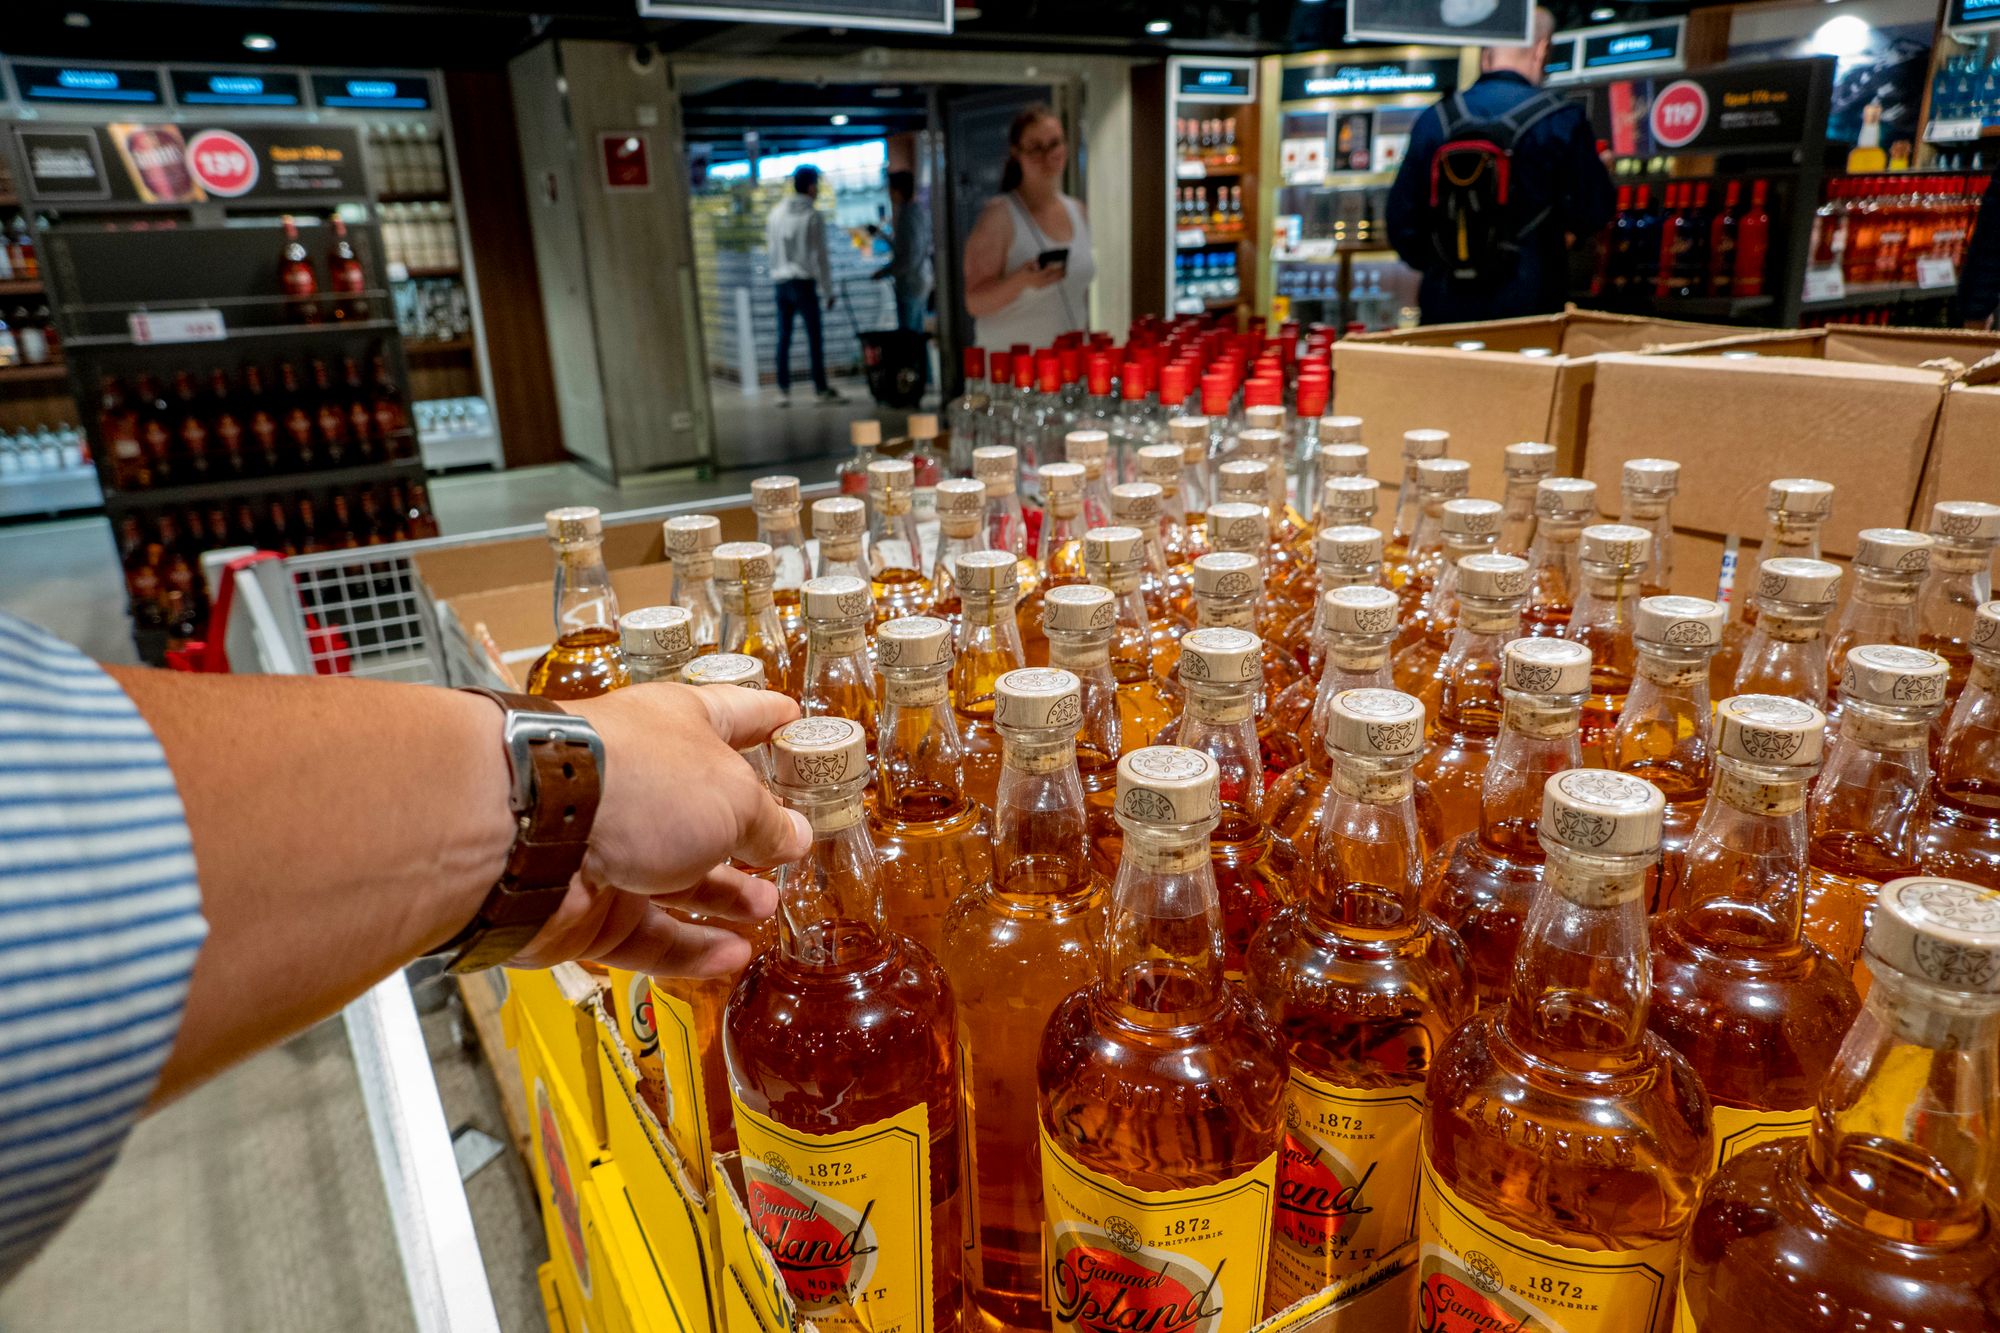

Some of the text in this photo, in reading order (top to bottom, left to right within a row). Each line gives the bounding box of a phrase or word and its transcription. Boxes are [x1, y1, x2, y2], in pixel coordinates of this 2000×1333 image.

[1661, 101, 1697, 127] 119
[1744, 738, 1797, 760] AQUAVIT
[798, 764, 845, 784] AQUAVIT
[1127, 791, 1171, 812] OPLAND
[1555, 817, 1609, 846] AQUAVIT
[1319, 1113, 1363, 1131] 1872
[797, 1173, 868, 1187] SPRITFABRIK
[808, 1163, 853, 1177] 1872
[1164, 1218, 1211, 1237] 1872
[1298, 1221, 1349, 1246] NORSK
[1147, 1230, 1224, 1248] SPRITFABRIK
[1283, 1225, 1375, 1260] QUAVIT
[1077, 1255, 1171, 1289] Gammel
[808, 1278, 858, 1294] NORSK
[1527, 1277, 1584, 1300] 1872
[794, 1287, 887, 1307] QUAVIT
[1509, 1284, 1600, 1311] SPRITFABRIK
[1437, 1284, 1532, 1333] Gammel
